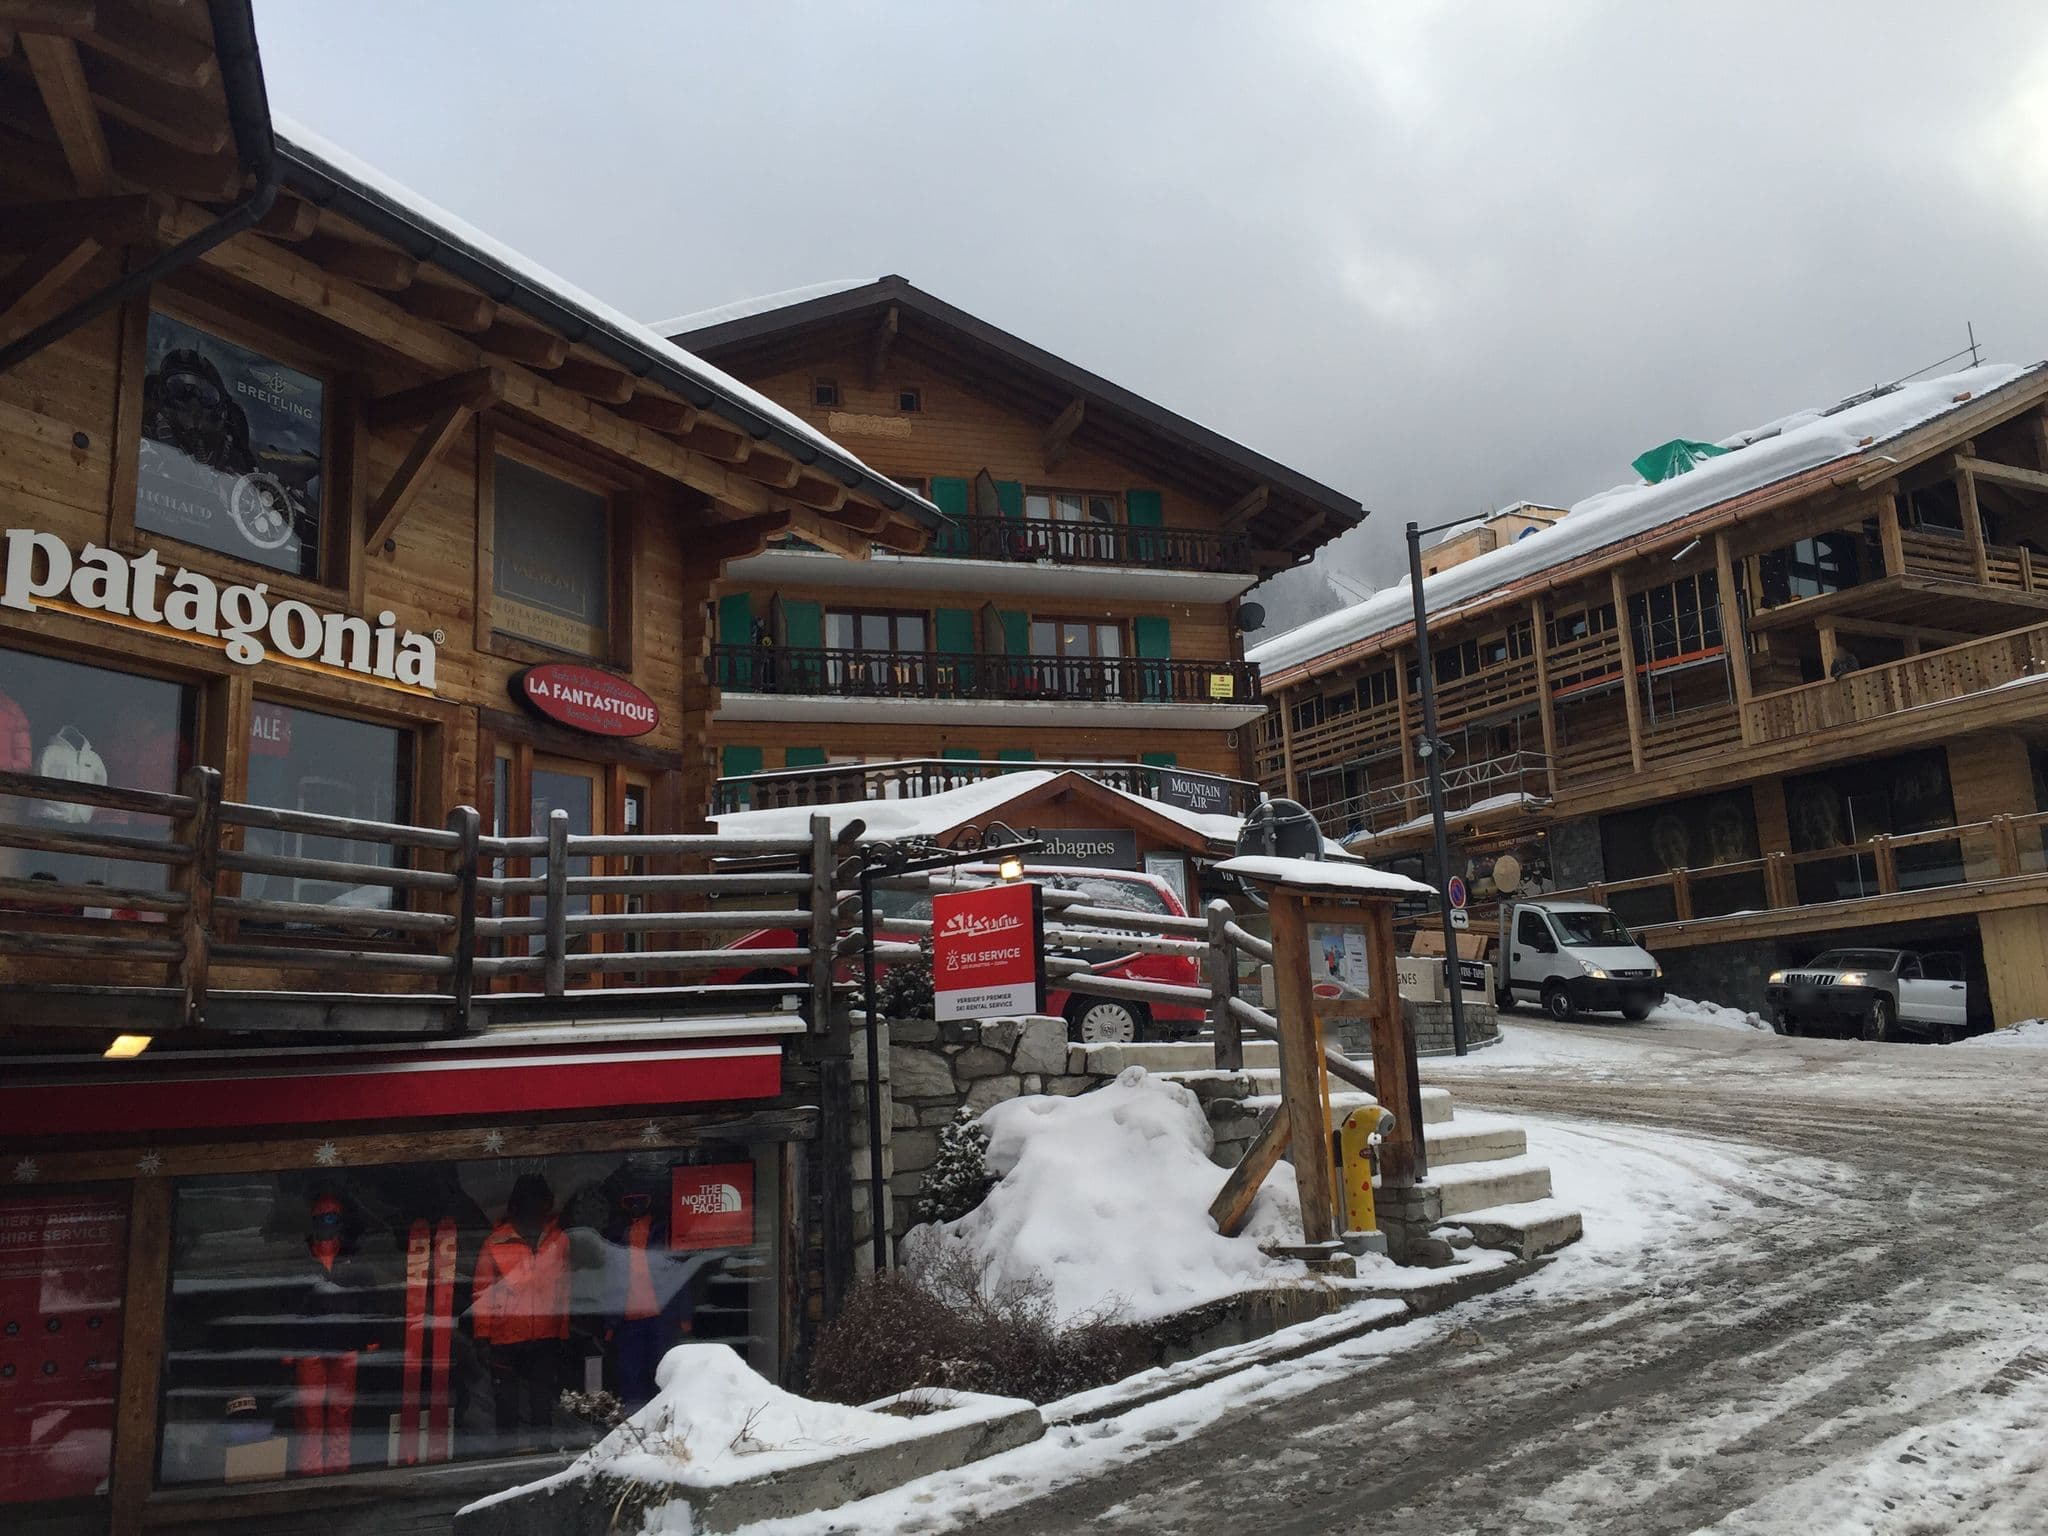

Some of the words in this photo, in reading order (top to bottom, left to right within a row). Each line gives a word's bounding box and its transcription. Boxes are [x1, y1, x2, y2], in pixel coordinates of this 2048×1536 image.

[237, 381, 312, 419] BREITLING
[529, 677, 550, 697] LA
[553, 683, 655, 723] FANTASTIQUE
[252, 715, 281, 740] ALE
[1171, 777, 1221, 798] MOUNTAIN
[1190, 795, 1208, 809] AIR
[1028, 838, 1115, 858] abagnes
[960, 952, 977, 963] SKI
[978, 947, 1021, 962] SERVICE
[986, 993, 1011, 1001] PREMIER
[989, 1000, 1013, 1008] SERVICE
[699, 1184, 721, 1195] THE
[681, 1194, 721, 1206] NORTH
[692, 1203, 721, 1214] FACE
[43, 1227, 113, 1241] SERVICE
